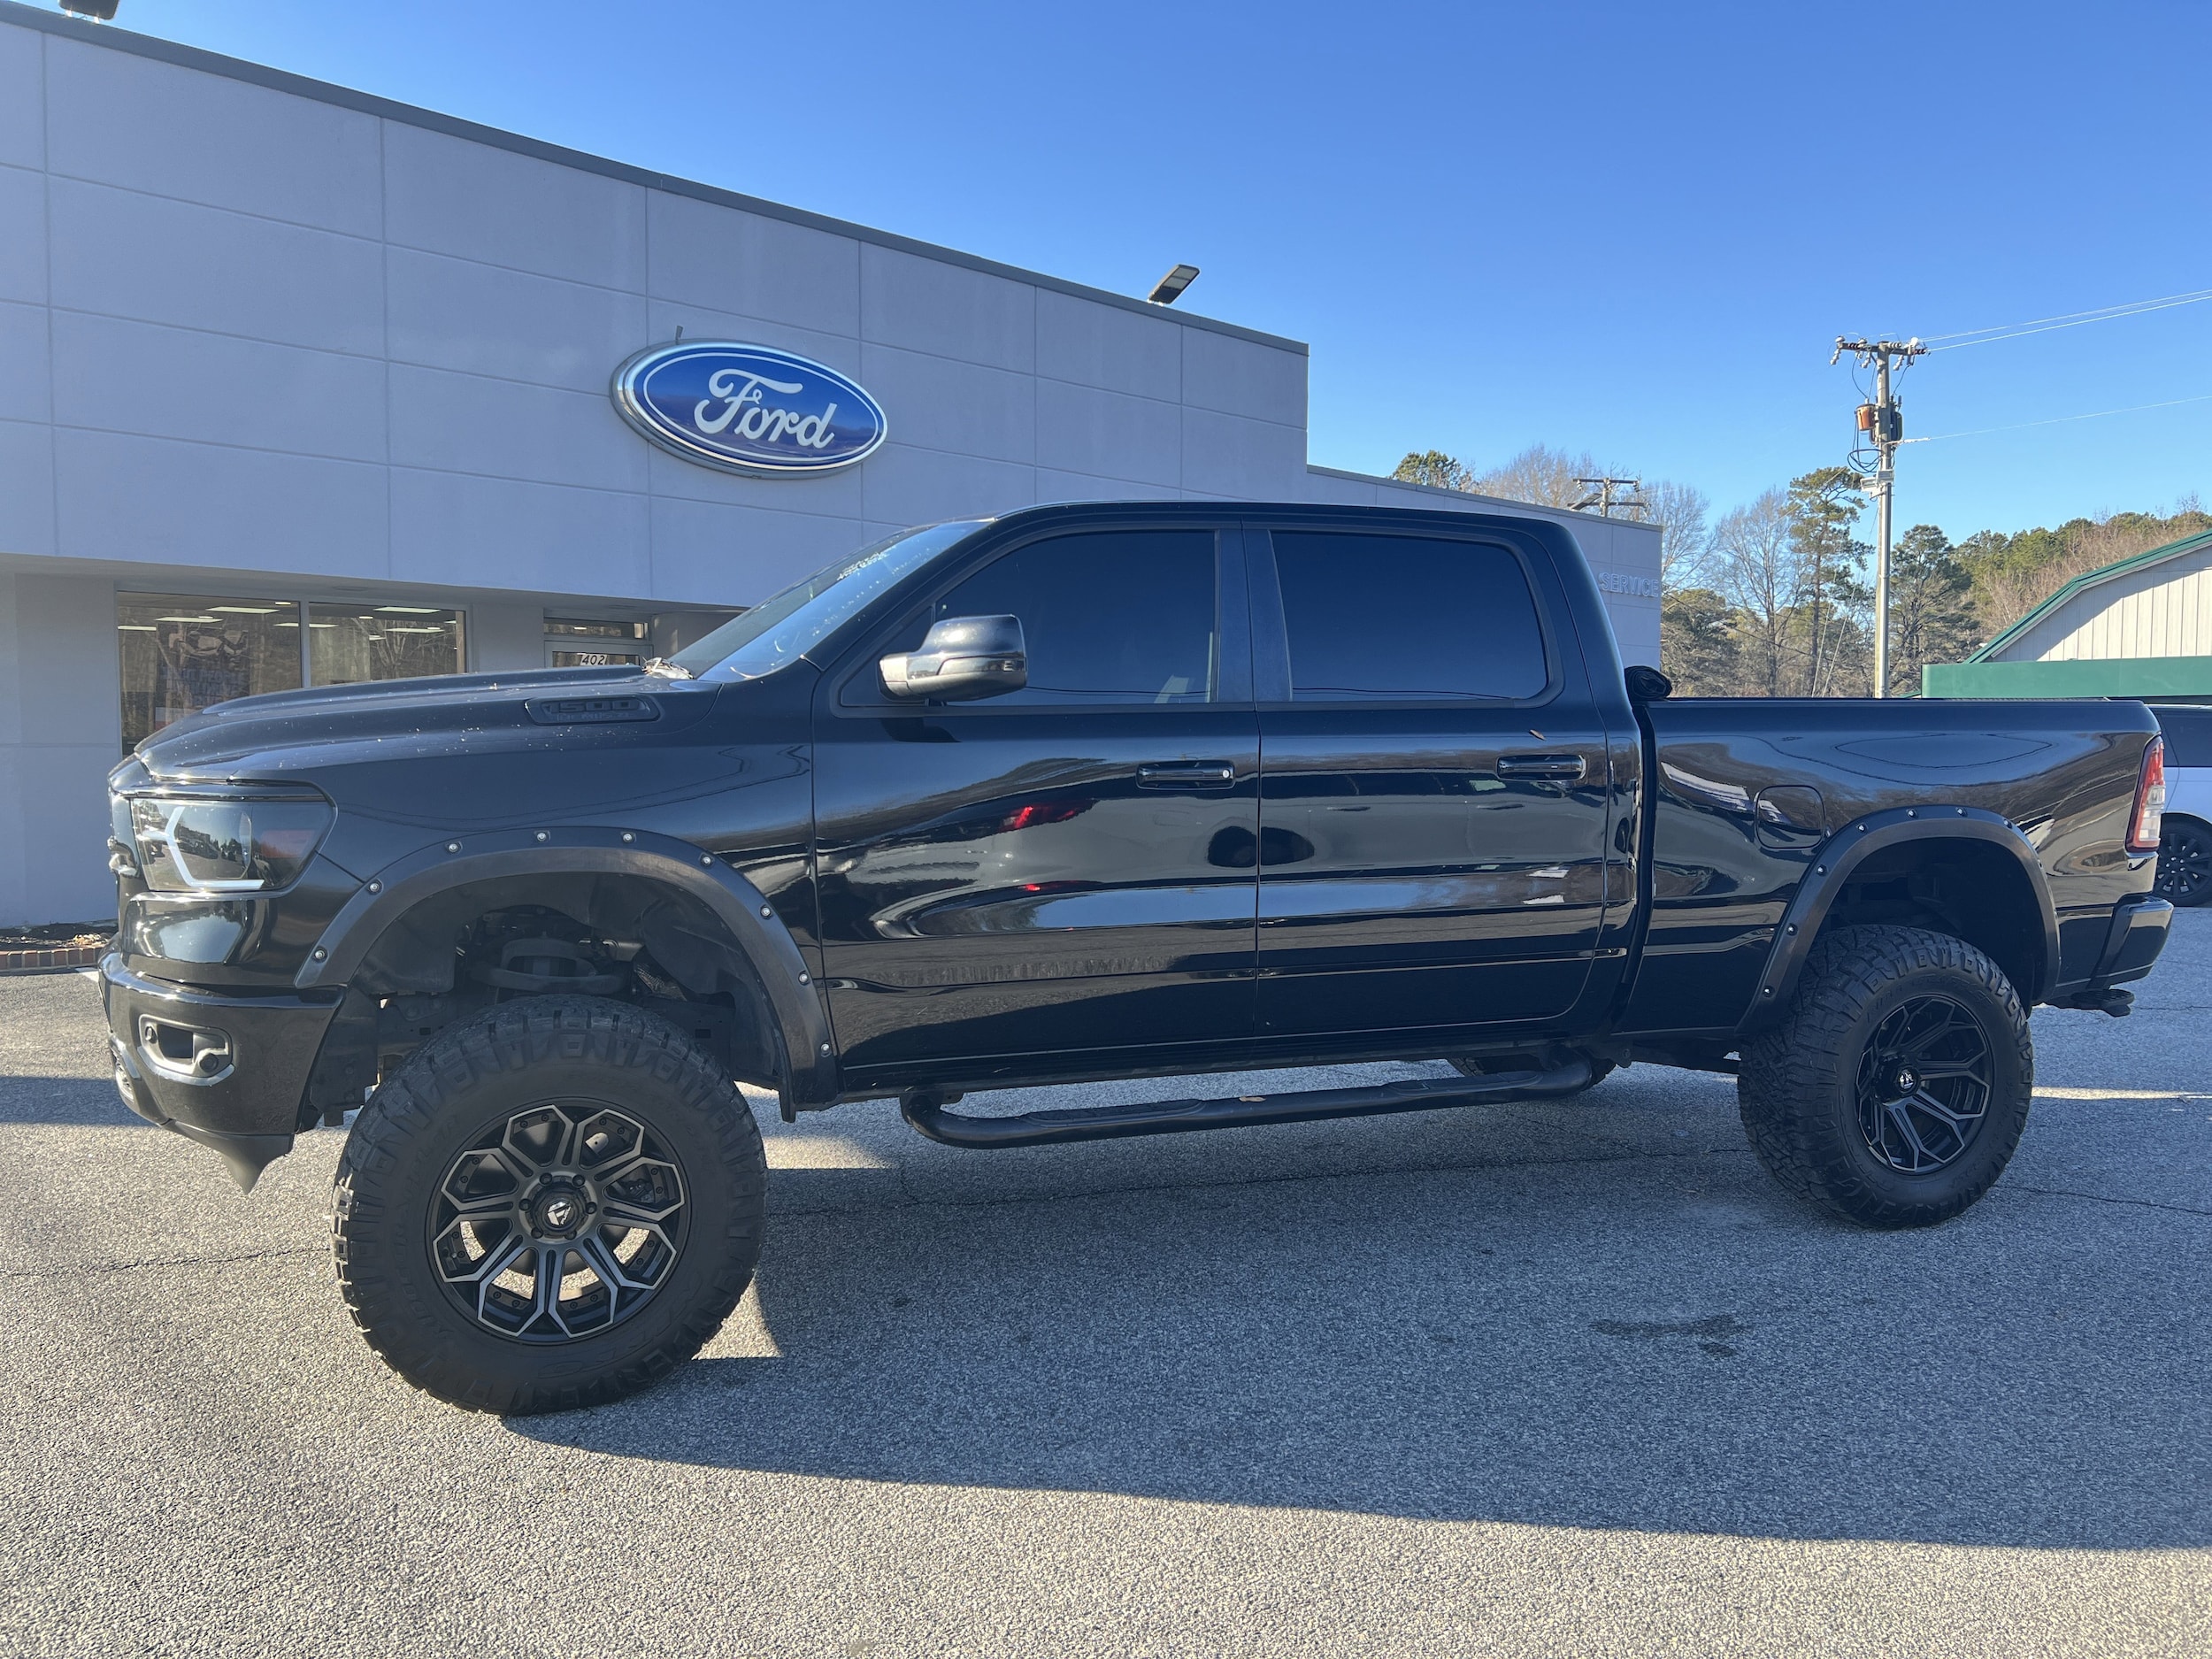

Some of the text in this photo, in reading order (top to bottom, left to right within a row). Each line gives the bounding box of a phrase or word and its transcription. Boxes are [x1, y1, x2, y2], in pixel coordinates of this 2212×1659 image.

[693, 368, 836, 449] Ford
[1598, 572, 1659, 598] SERVICE
[581, 655, 605, 665] 402
[541, 699, 639, 714] 1500
